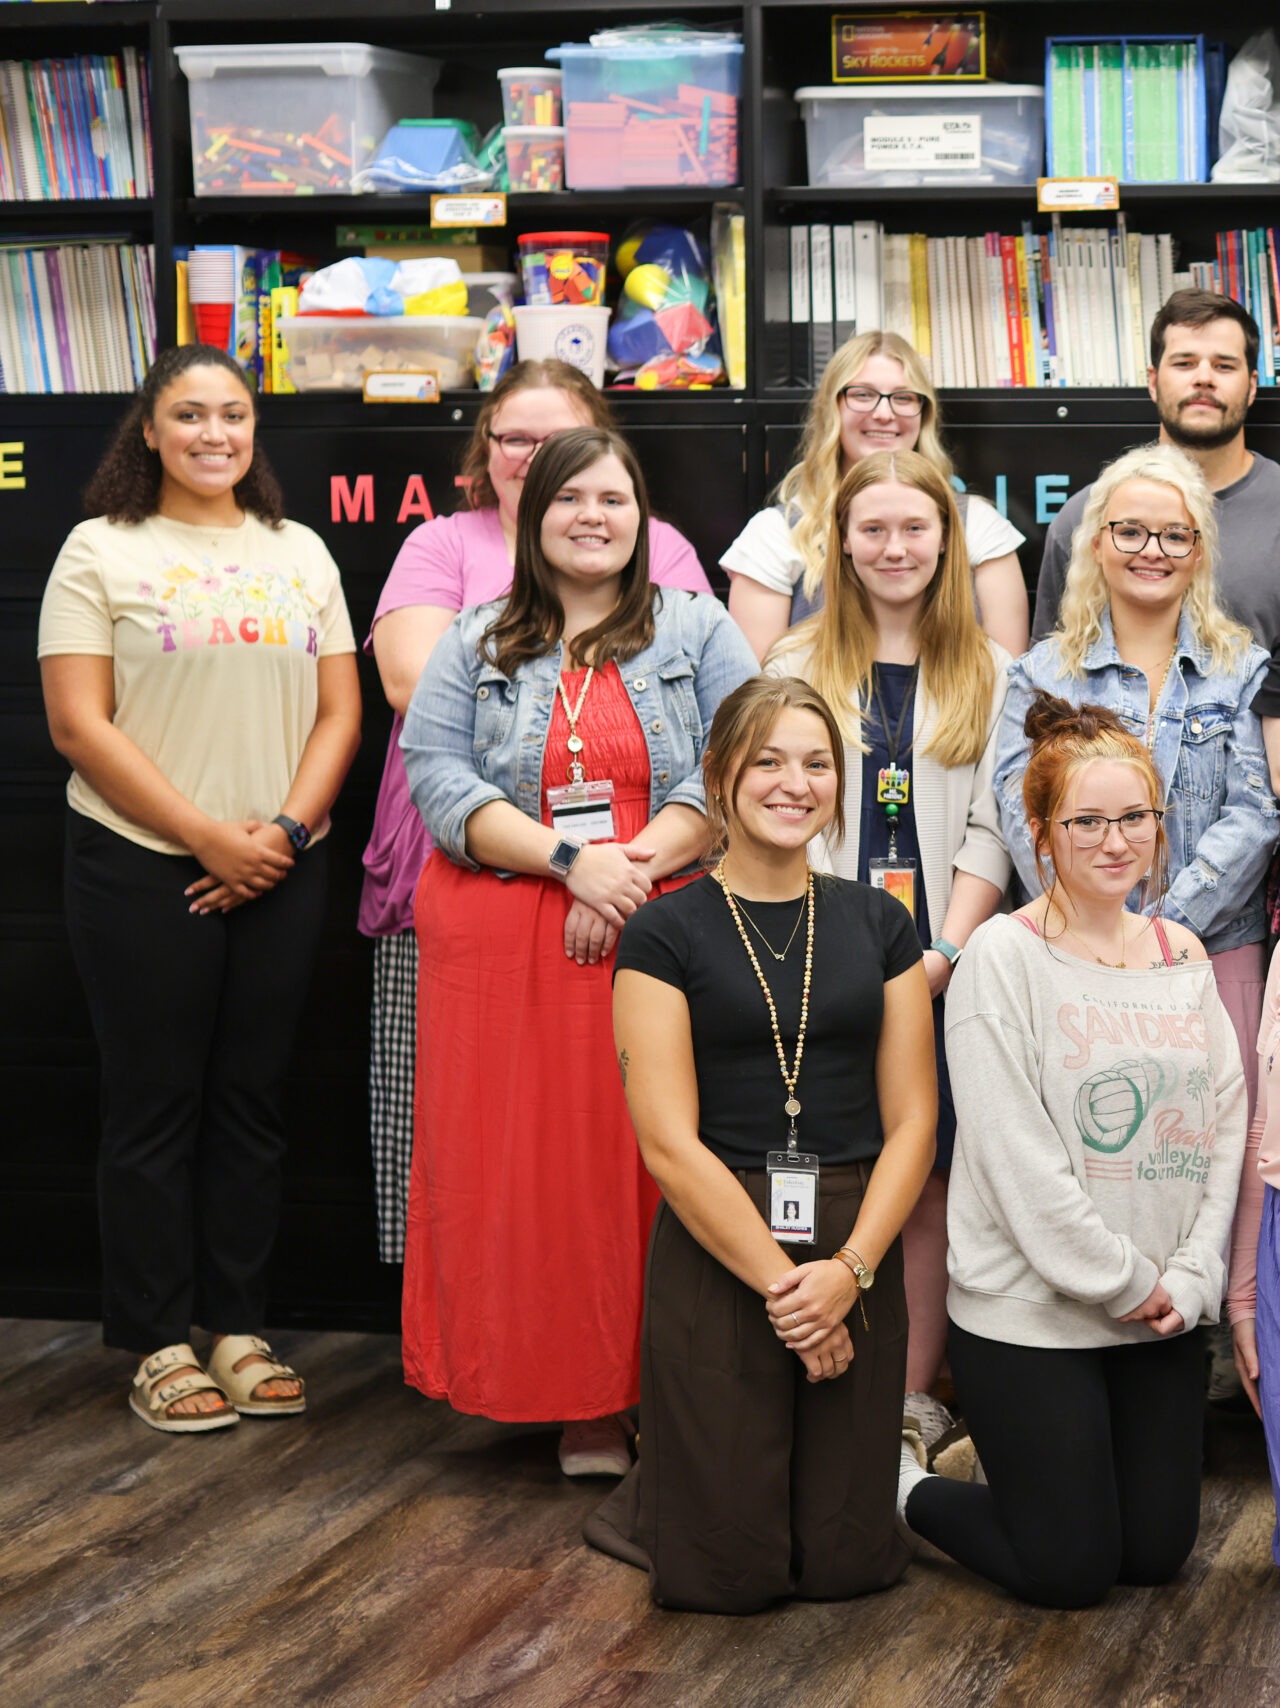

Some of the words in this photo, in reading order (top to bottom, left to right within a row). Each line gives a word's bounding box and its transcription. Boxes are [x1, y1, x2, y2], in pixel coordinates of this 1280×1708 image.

[842, 55, 867, 69] SKY
[869, 54, 926, 68] ROCKETS
[0, 441, 26, 490] E
[157, 616, 318, 657] TEACHER
[1057, 1003, 1140, 1070] SAN
[1154, 1108, 1215, 1150] Beach
